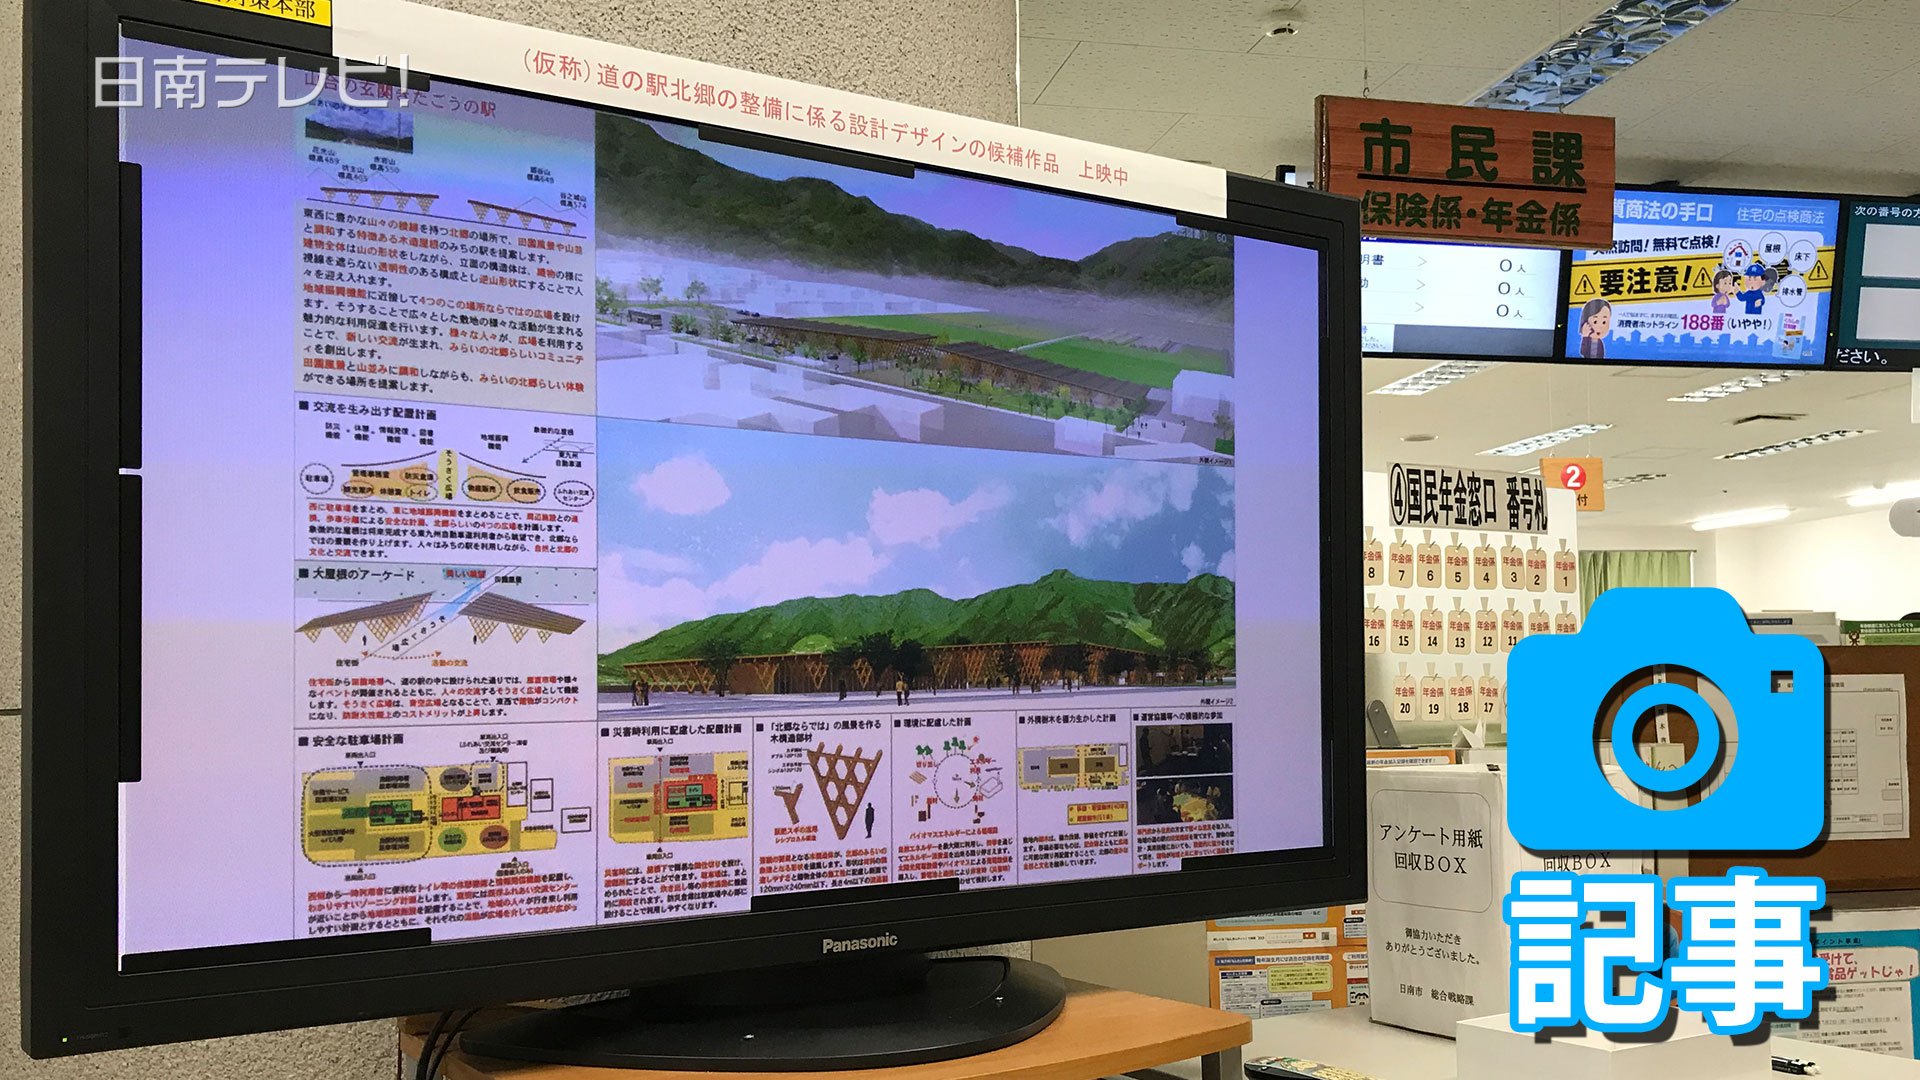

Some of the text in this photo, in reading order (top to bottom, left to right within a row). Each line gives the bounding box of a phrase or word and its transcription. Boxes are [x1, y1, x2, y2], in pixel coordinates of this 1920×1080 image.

[1360, 117, 1587, 187] 市民課
[1078, 160, 1130, 188] 上映中
[1361, 189, 1582, 238] 保険係・年金係
[1736, 208, 1825, 225] 住宅の点検商法
[1764, 243, 1781, 254] 屋根
[1794, 252, 1811, 262] 床下
[1517, 264, 1526, 273] 人
[1599, 265, 1693, 296] 要注意!
[1515, 287, 1524, 296] 人
[1514, 310, 1523, 318] 人
[1617, 320, 1679, 329] 消費者ホットライン
[1680, 314, 1725, 331] 188番
[313, 401, 437, 420] 交流を生み出す配置計画
[1566, 465, 1581, 488] 2
[1505, 475, 1549, 532] 番号札
[313, 568, 415, 580] 大屋根のアーケード
[1368, 567, 1375, 578] 8
[1398, 569, 1405, 581] 7
[1427, 570, 1434, 581] 6
[1454, 571, 1461, 583] 5
[1483, 572, 1490, 583] 4
[1510, 571, 1517, 582] 3
[1534, 574, 1540, 586] 2
[1563, 576, 1568, 587] 1
[1368, 635, 1380, 647] 16
[1398, 635, 1409, 647] 15
[1427, 636, 1438, 647] 14
[1455, 637, 1465, 648] 13
[1482, 636, 1493, 647] 12
[1400, 703, 1411, 714] 20
[1428, 703, 1439, 714] 19
[1458, 702, 1469, 713] 18
[1483, 702, 1493, 713] 17
[1380, 823, 1483, 849] アンケート用紙
[1394, 852, 1467, 874] 回収BOX
[1405, 927, 1462, 946] 御協力いただき
[823, 932, 898, 954] Panasonic
[1385, 941, 1480, 965] ありがとうございました。
[1400, 983, 1475, 1006] 日南市 総合戦略課
